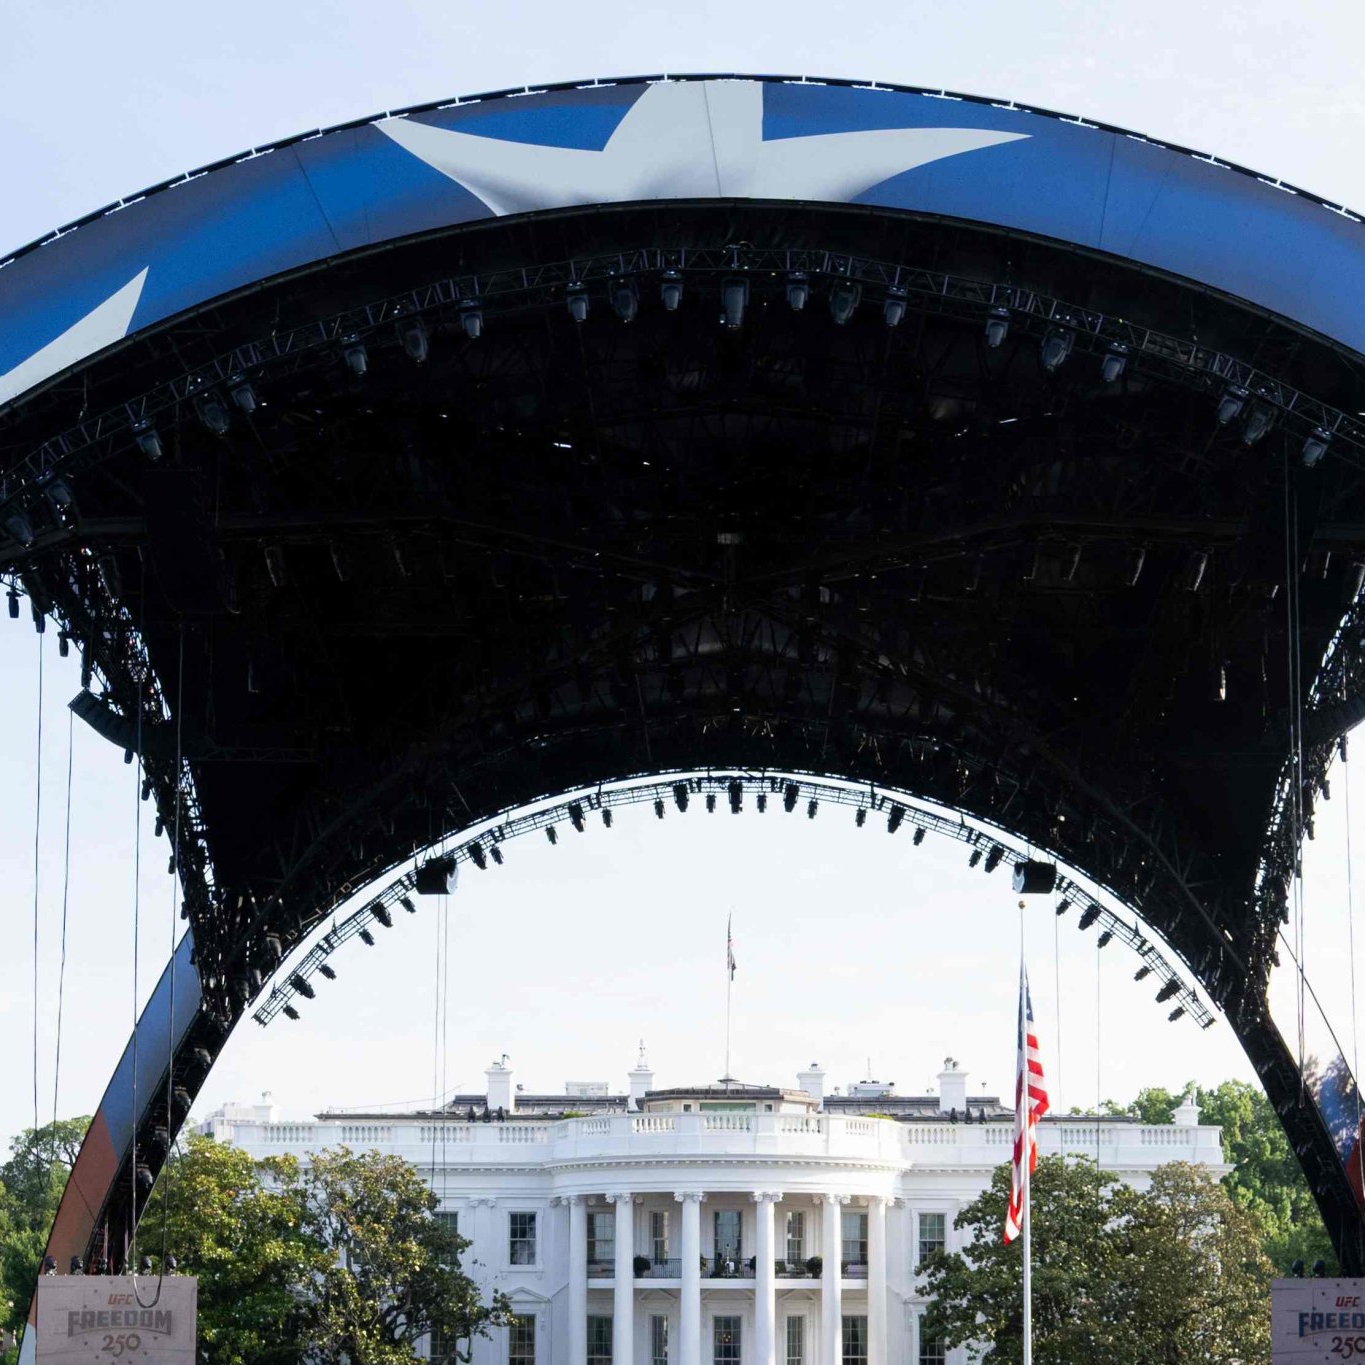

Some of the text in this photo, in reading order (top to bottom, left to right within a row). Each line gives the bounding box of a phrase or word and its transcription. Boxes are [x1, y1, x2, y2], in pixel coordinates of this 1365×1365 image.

[108, 1293, 134, 1306] UFC
[1335, 1296, 1361, 1308] UFC
[68, 1310, 172, 1338] FREEDOM
[101, 1333, 141, 1358] 250
